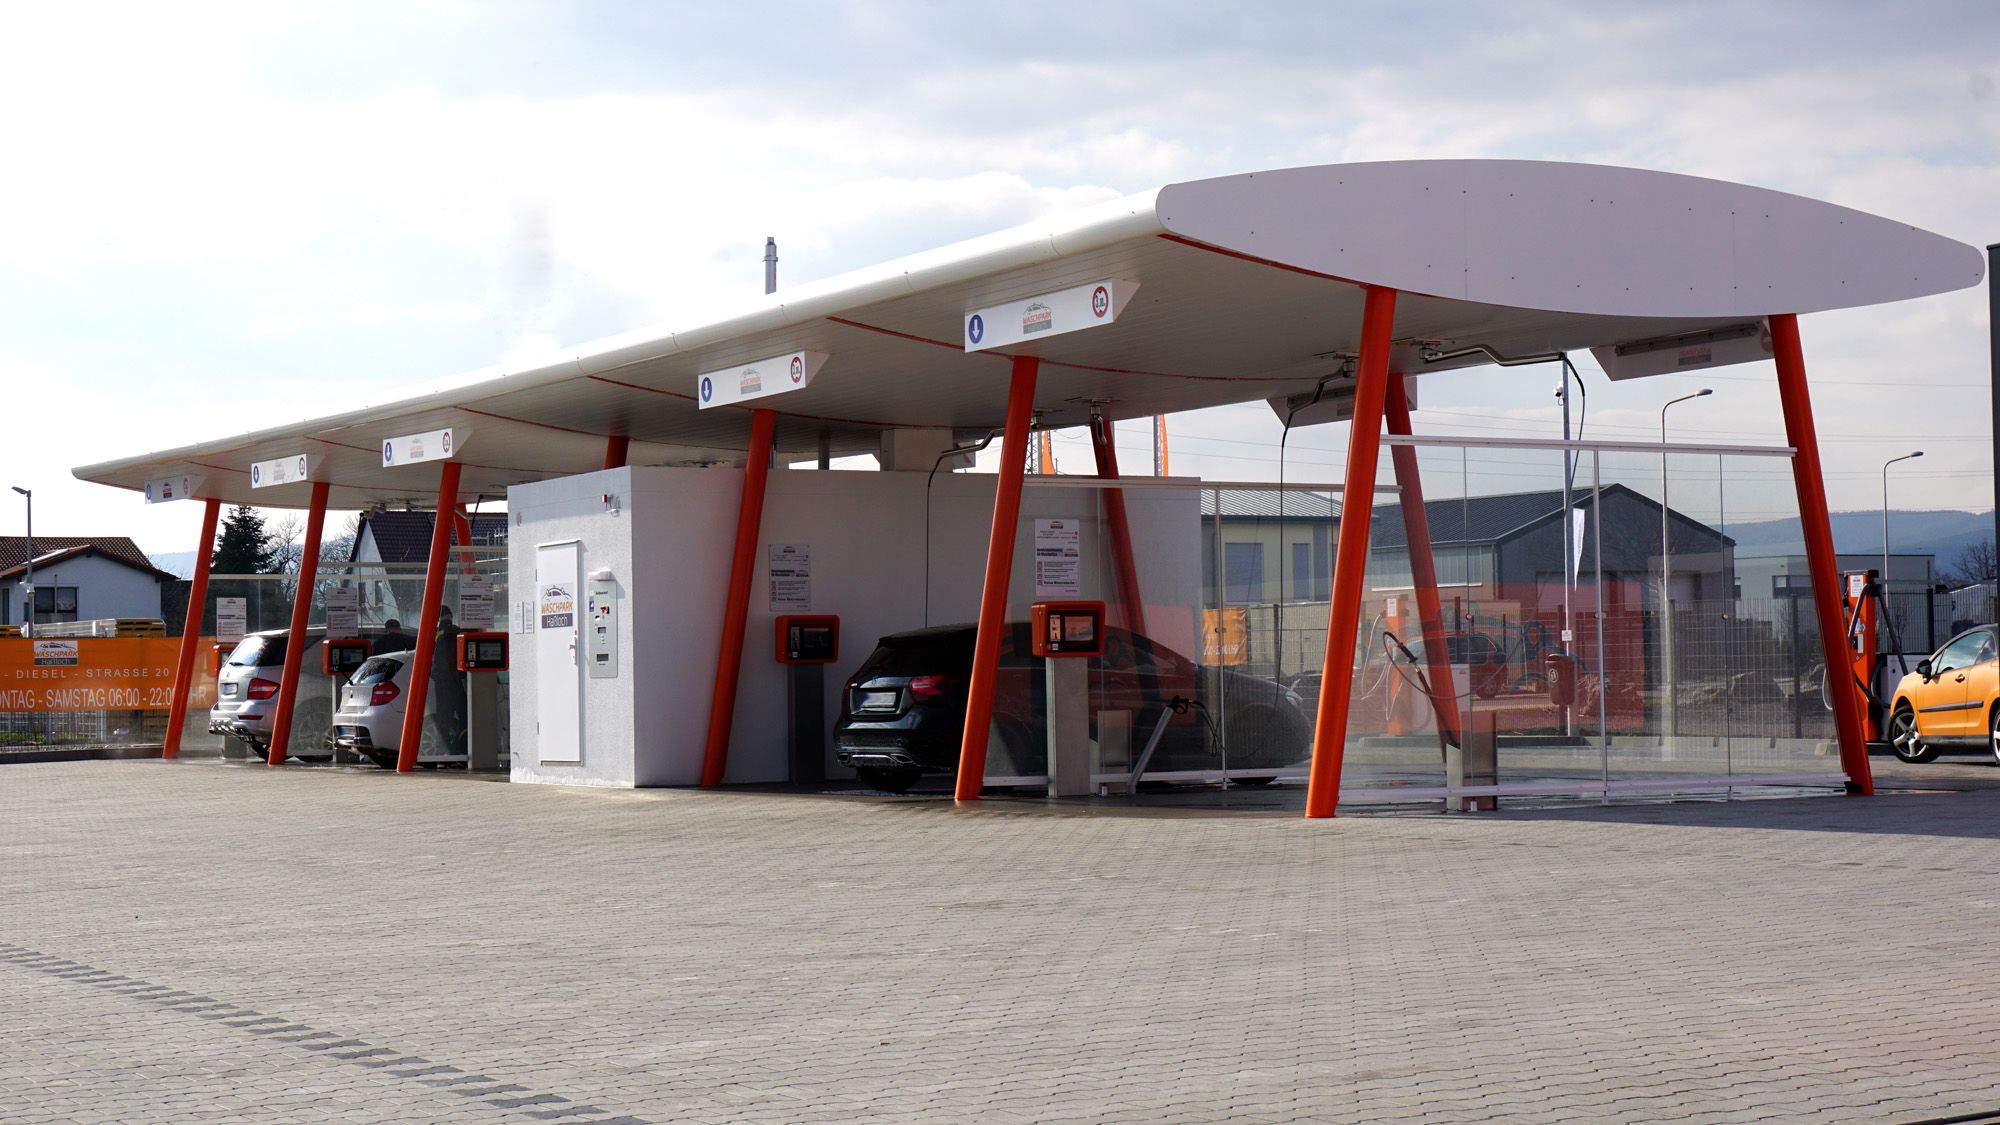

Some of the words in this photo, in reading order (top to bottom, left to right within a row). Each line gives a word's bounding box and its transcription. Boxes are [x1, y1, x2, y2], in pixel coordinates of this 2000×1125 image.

[541, 601, 573, 614] WASCHPARK
[546, 615, 568, 627] Haßloch
[34, 650, 78, 658] WASCHPARK
[16, 669, 67, 679] DIESEL
[86, 668, 149, 678] STRASSE
[155, 668, 170, 677] 20
[0, 688, 35, 708] NTAG
[46, 688, 105, 708] SAMSTAG
[109, 688, 140, 707] 06:00
